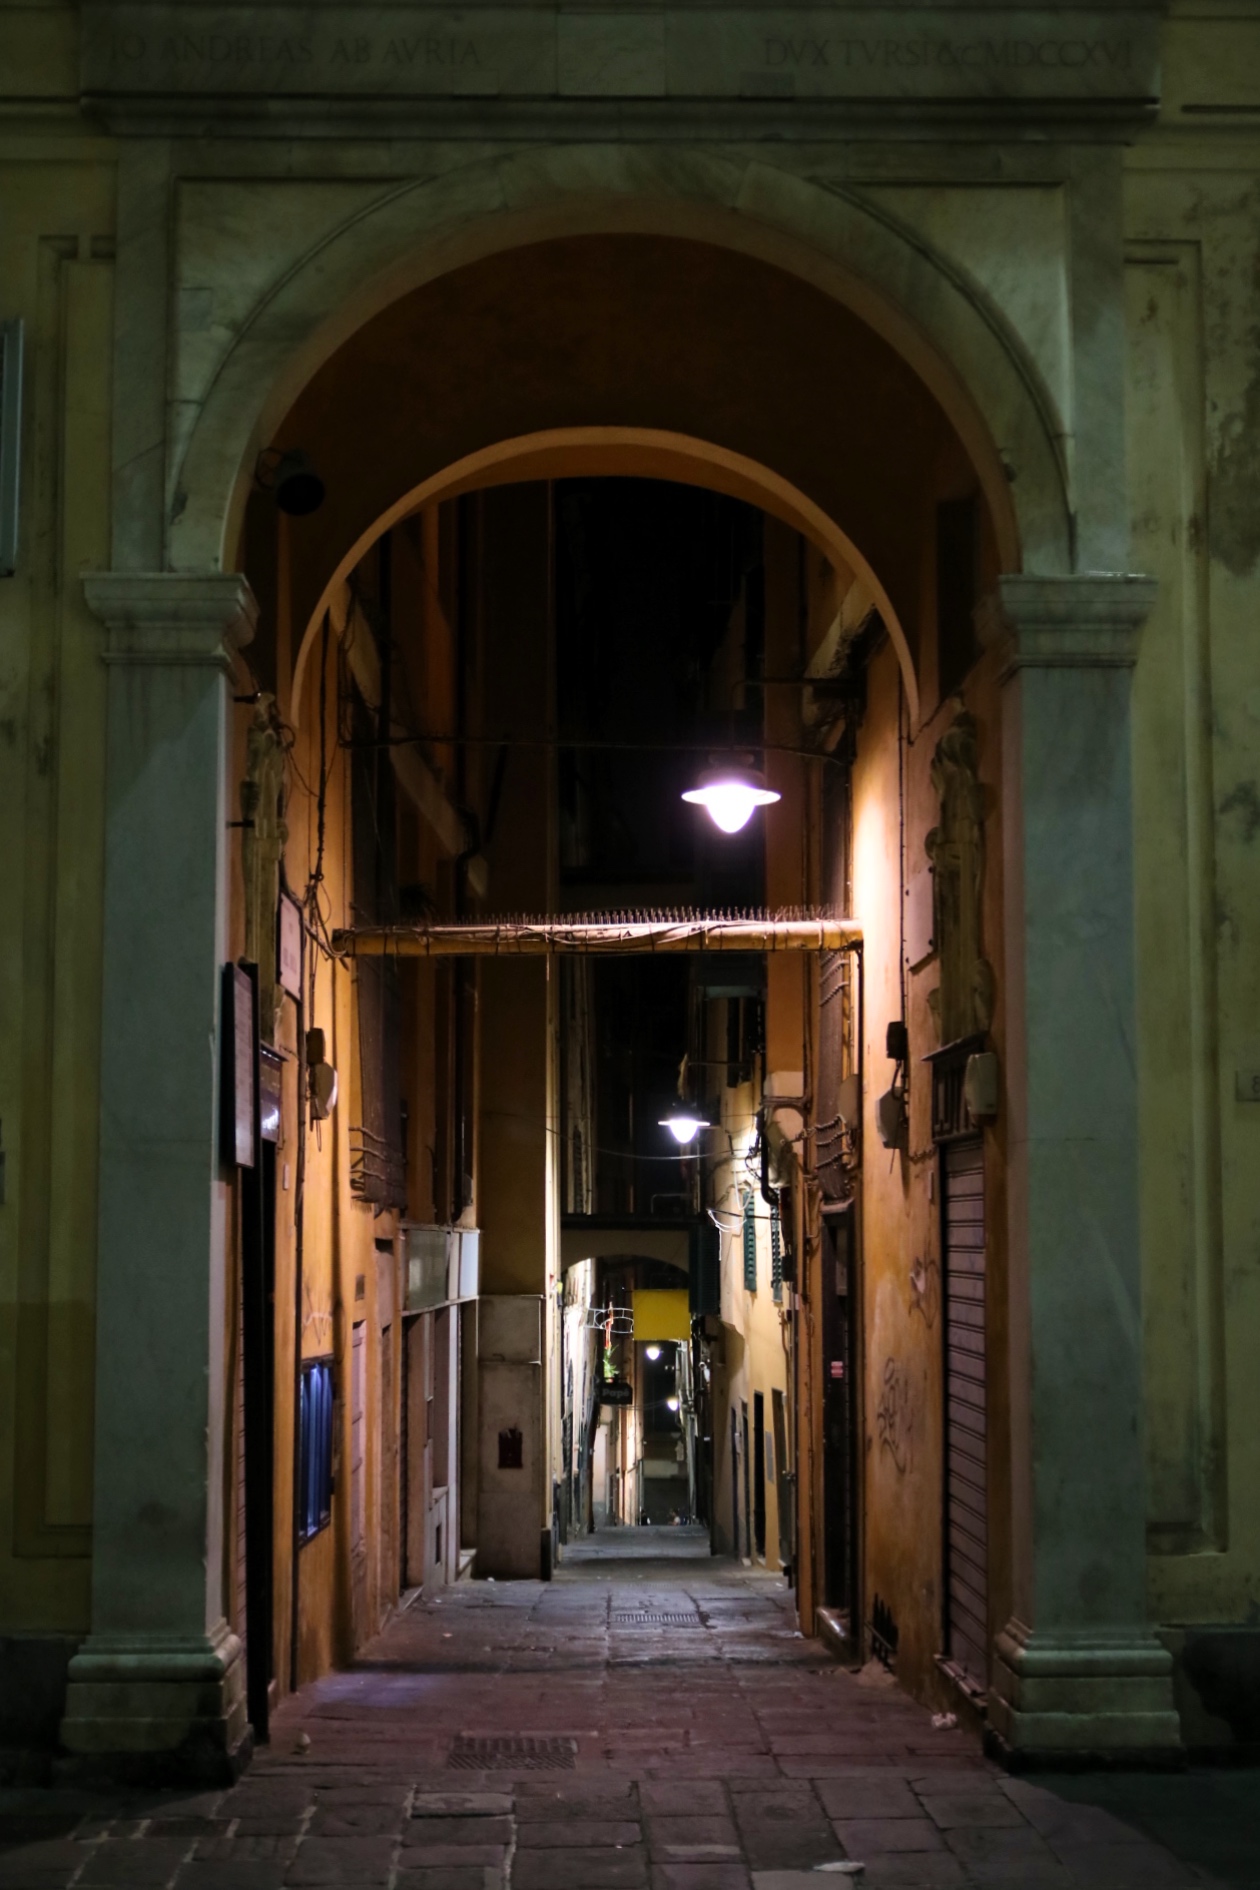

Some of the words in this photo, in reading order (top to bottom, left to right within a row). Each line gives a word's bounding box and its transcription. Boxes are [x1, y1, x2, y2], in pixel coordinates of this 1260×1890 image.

[161, 35, 313, 63] ANDREAS
[329, 36, 371, 63] AB
[380, 37, 481, 65] AVRIA
[765, 38, 830, 66] DVX
[837, 38, 929, 67] TVRSI
